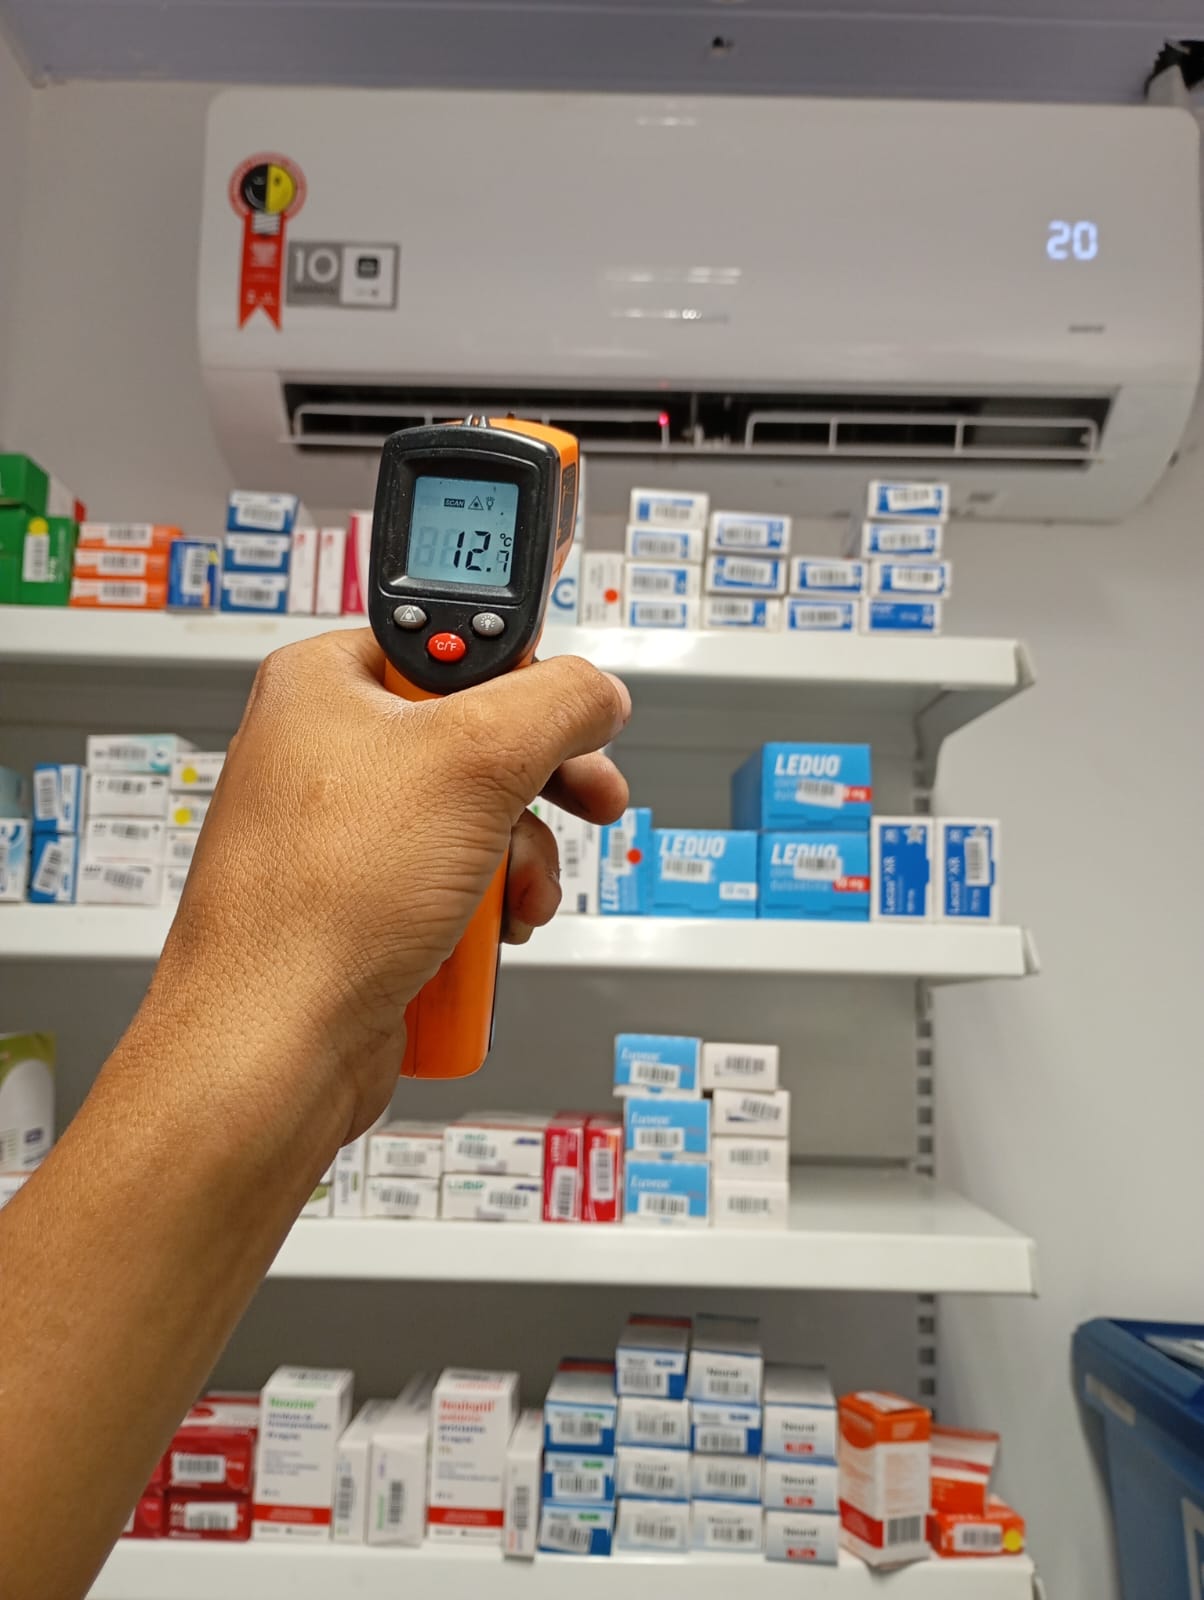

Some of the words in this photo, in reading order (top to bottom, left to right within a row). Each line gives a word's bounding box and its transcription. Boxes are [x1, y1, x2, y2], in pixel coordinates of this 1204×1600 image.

[1046, 219, 1098, 260] 20
[445, 499, 464, 508] SCAN
[453, 530, 509, 573] 12.7
[774, 753, 841, 776] LEDUO
[659, 835, 726, 858] LEDUO
